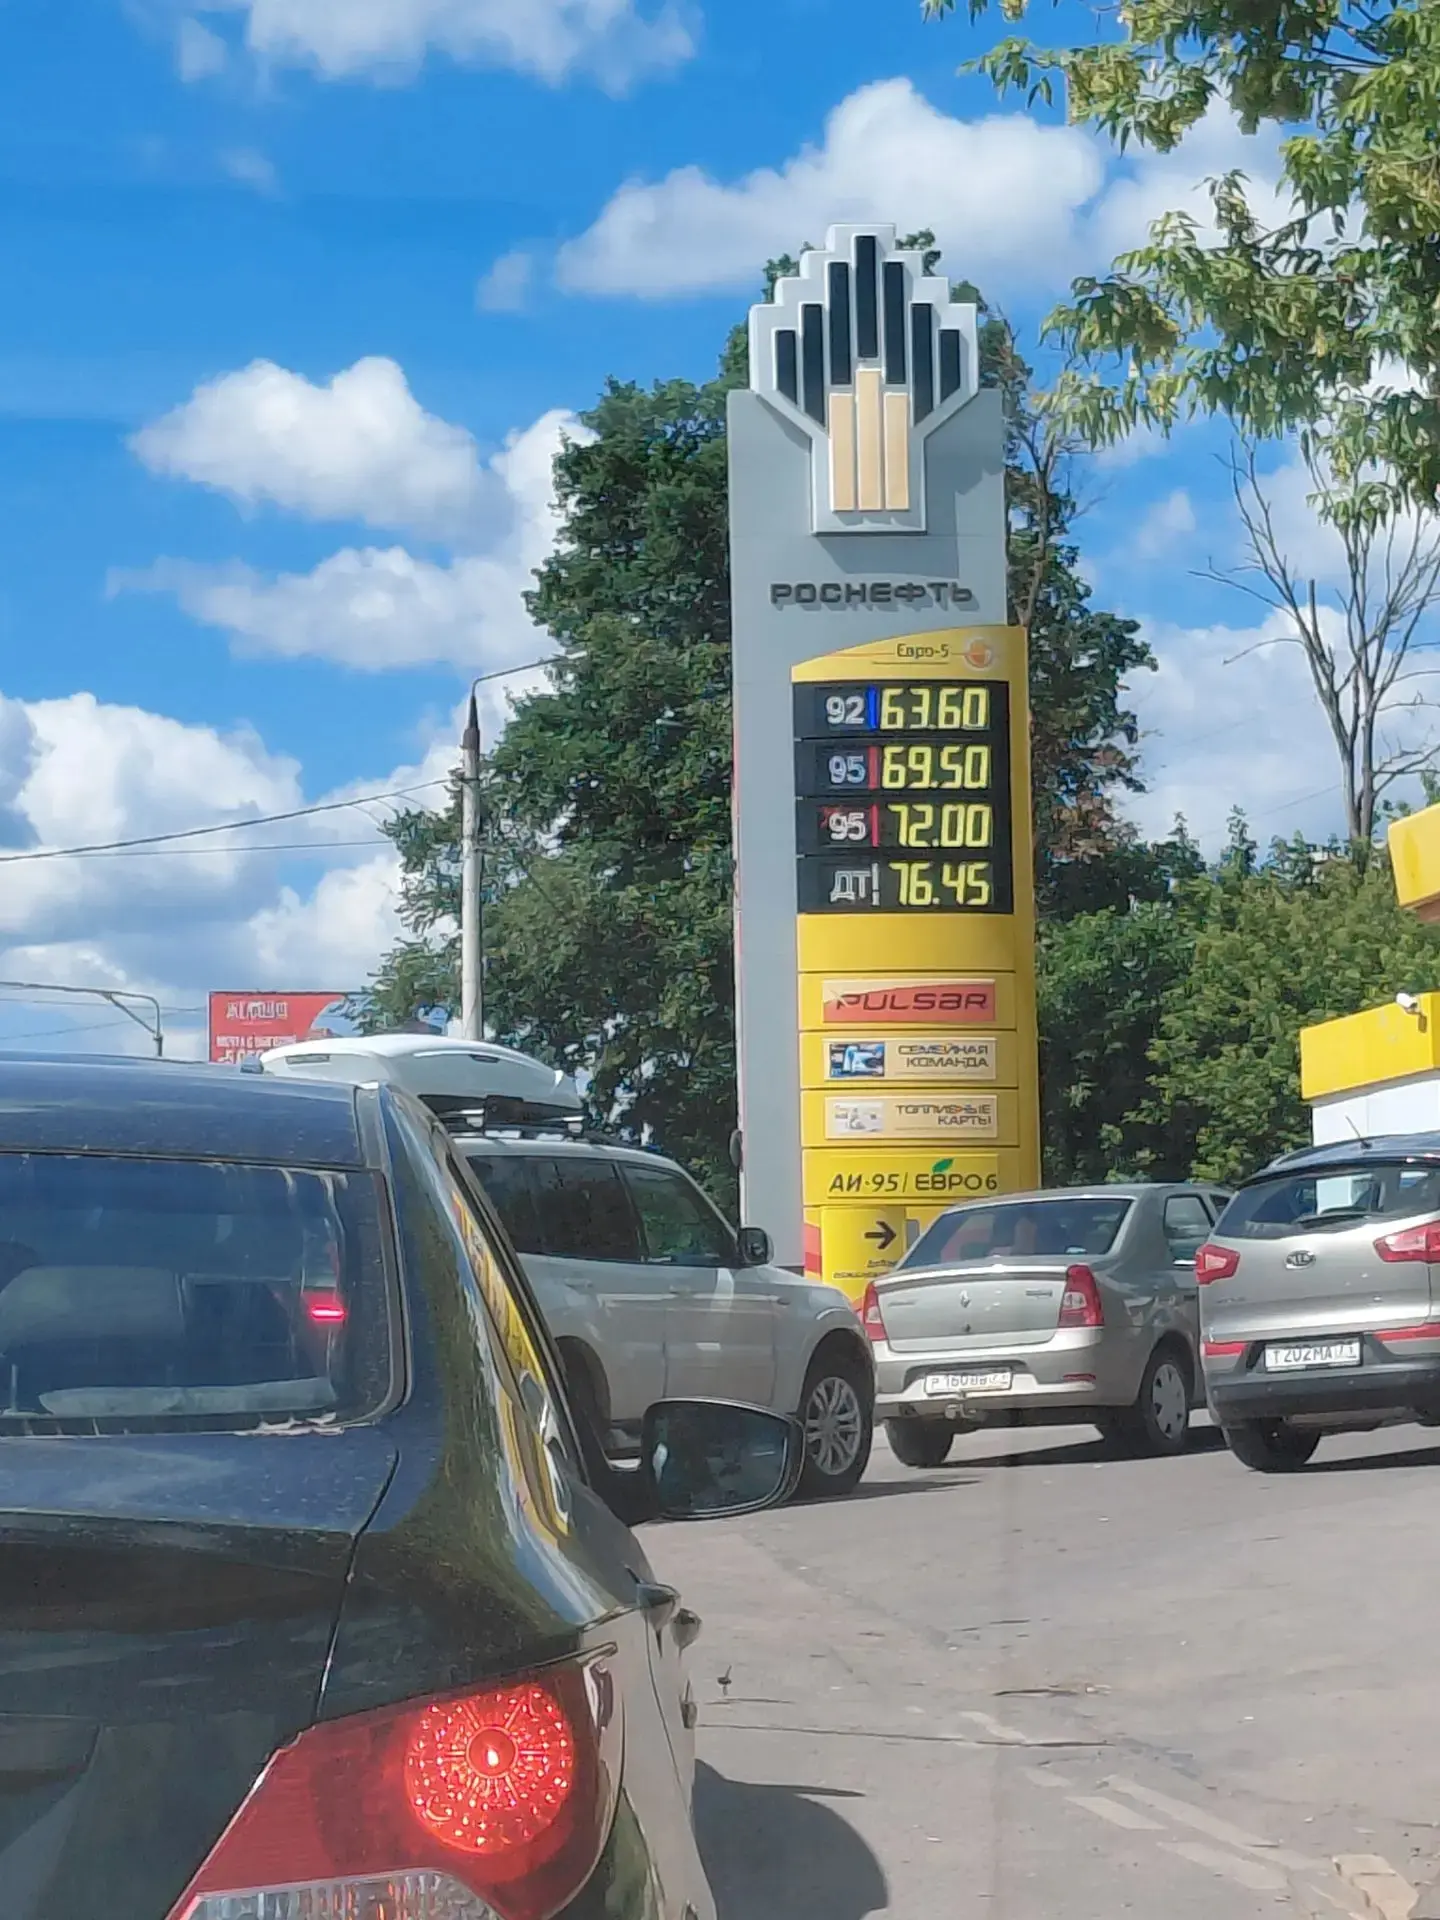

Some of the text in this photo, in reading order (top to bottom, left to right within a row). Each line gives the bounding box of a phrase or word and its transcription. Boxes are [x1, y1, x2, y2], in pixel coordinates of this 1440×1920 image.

[770, 582, 974, 604] РОСНЕФТЬ
[896, 643, 949, 660] Евро-5
[826, 687, 990, 730] 92 63.60
[828, 746, 989, 789] 95 69.50
[829, 804, 993, 847] 95 72.00
[888, 862, 990, 906] 76.45
[898, 1042, 988, 1055] СЕМЕЙНАЯ
[906, 1057, 989, 1069] КОМАНДА
[938, 1115, 992, 1125] КАРТЫ
